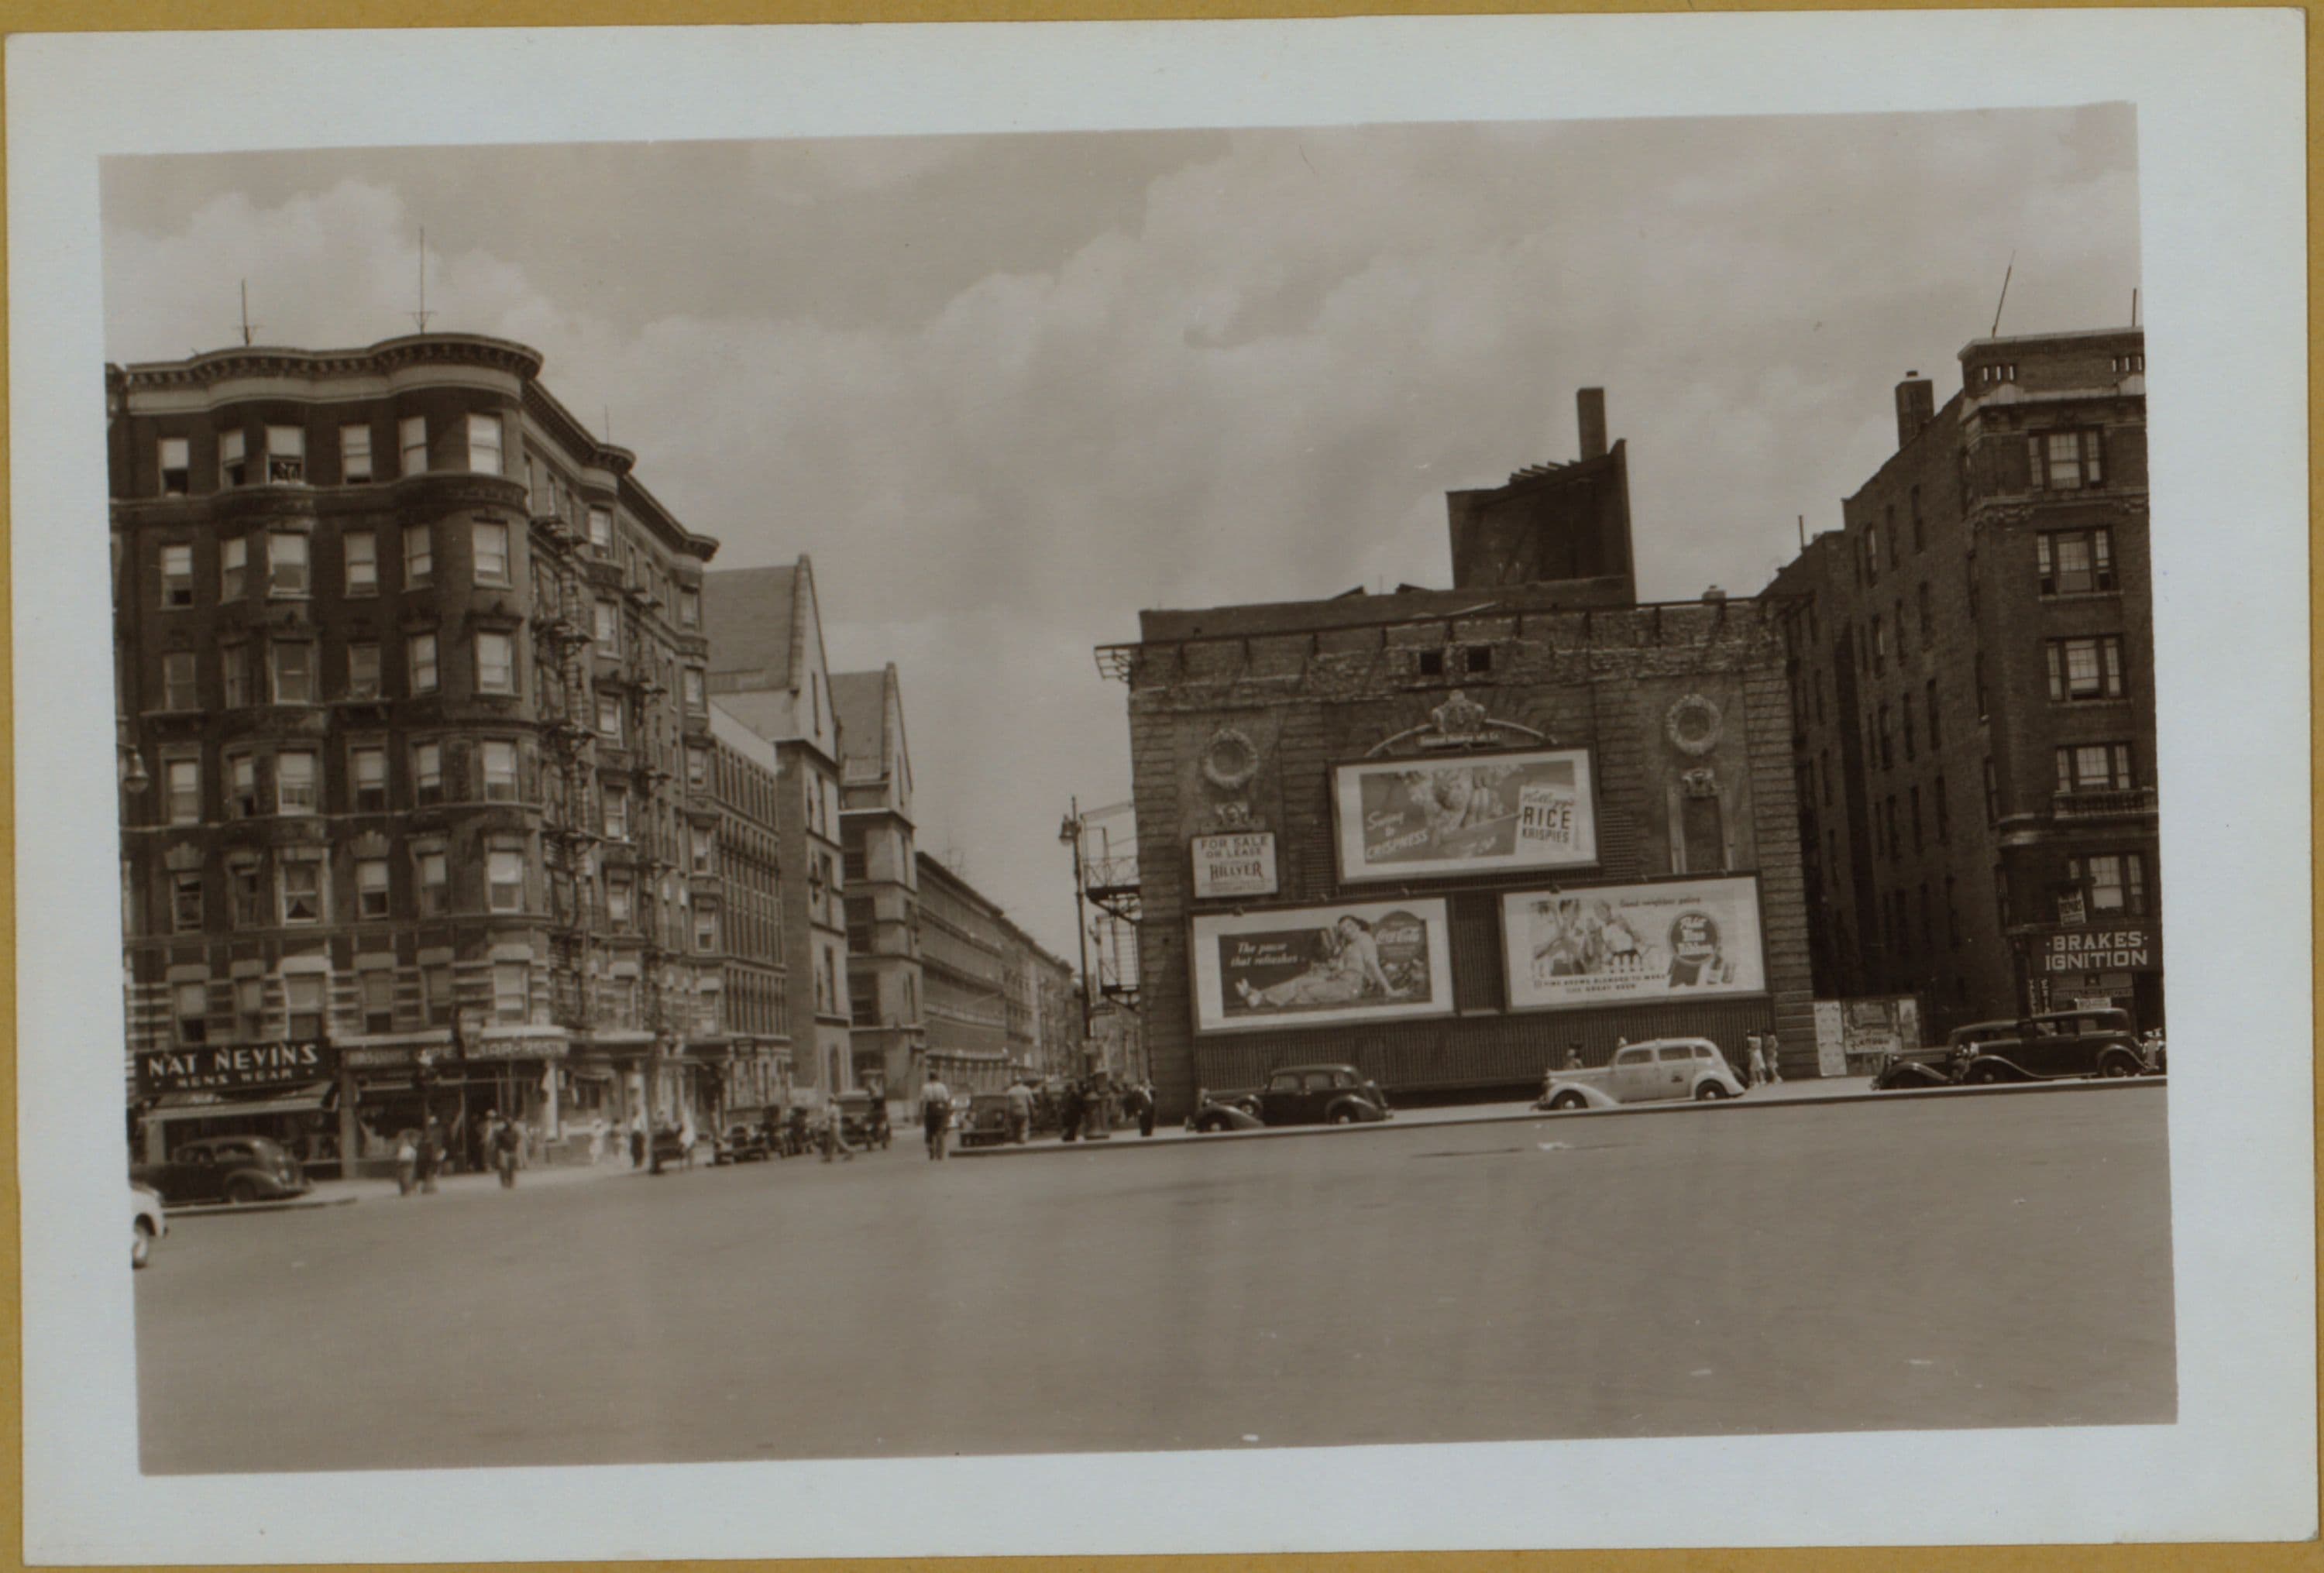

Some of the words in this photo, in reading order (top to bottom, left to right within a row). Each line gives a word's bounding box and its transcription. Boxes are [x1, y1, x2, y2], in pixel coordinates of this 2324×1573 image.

[1524, 806, 1571, 829] RICE
[1202, 839, 1227, 849] FOR
[1233, 836, 1267, 847] SALE
[1522, 828, 1569, 844] KRISPIES
[1227, 847, 1262, 858] LEASE
[1238, 942, 1257, 954] The
[1258, 943, 1287, 955] pause
[2052, 931, 2143, 952] BRAKES
[1230, 954, 1252, 967] that
[2045, 950, 2147, 970] IGNITION
[148, 1055, 198, 1077] NAT
[215, 1044, 318, 1071] NEVINS
[241, 1068, 293, 1083] WEAR
